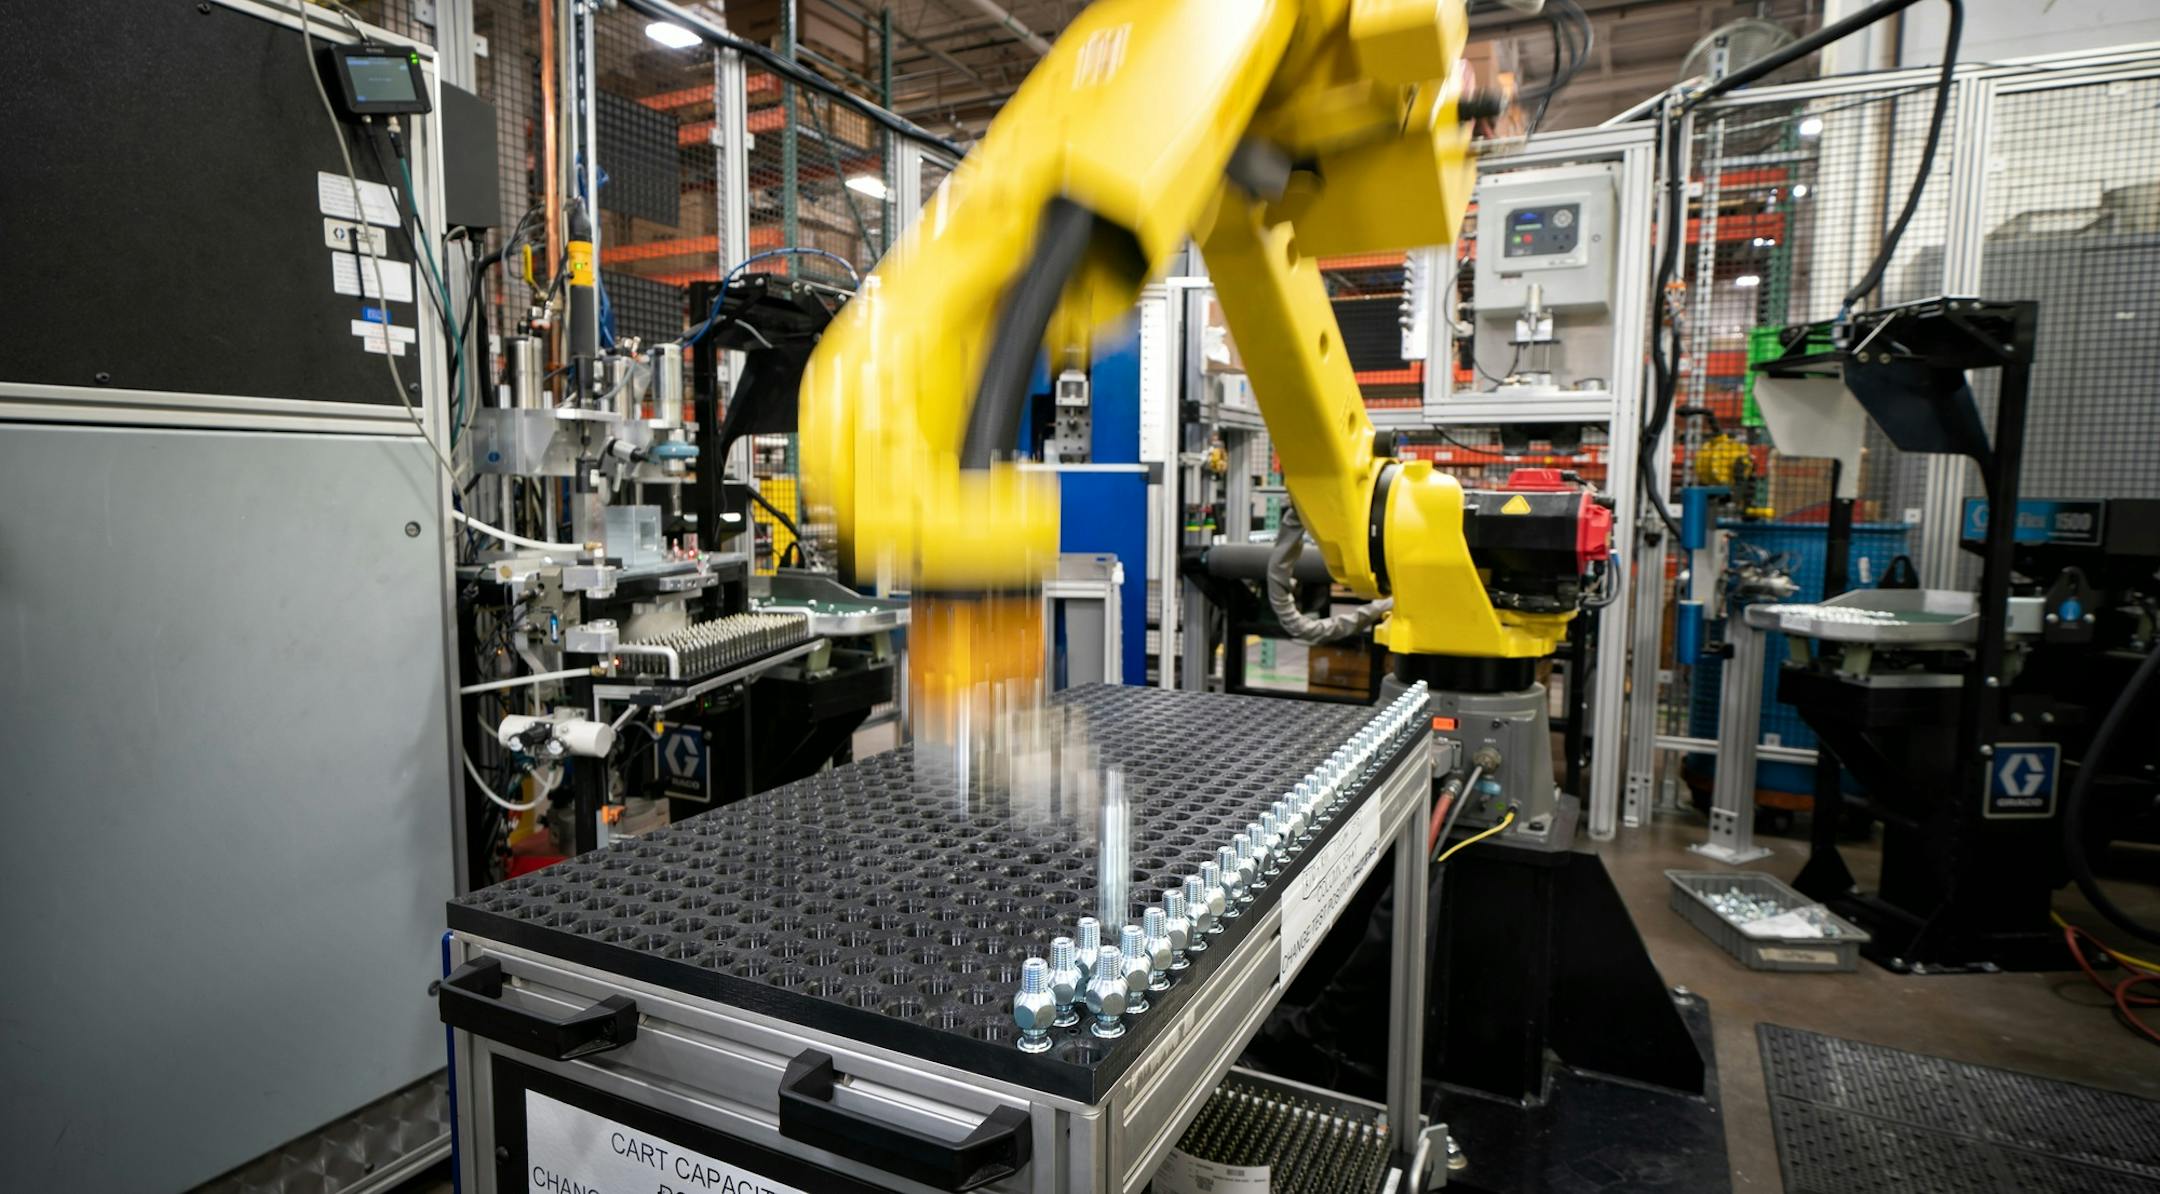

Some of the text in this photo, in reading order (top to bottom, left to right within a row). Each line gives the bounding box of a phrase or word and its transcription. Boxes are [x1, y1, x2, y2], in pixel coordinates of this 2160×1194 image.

[2055, 512, 2093, 531] 1500
[666, 775, 700, 790] RACO
[1281, 923, 1310, 975] CHANGE
[611, 1132, 775, 1194] CART CAPAC
[533, 1166, 599, 1194] CHAN
